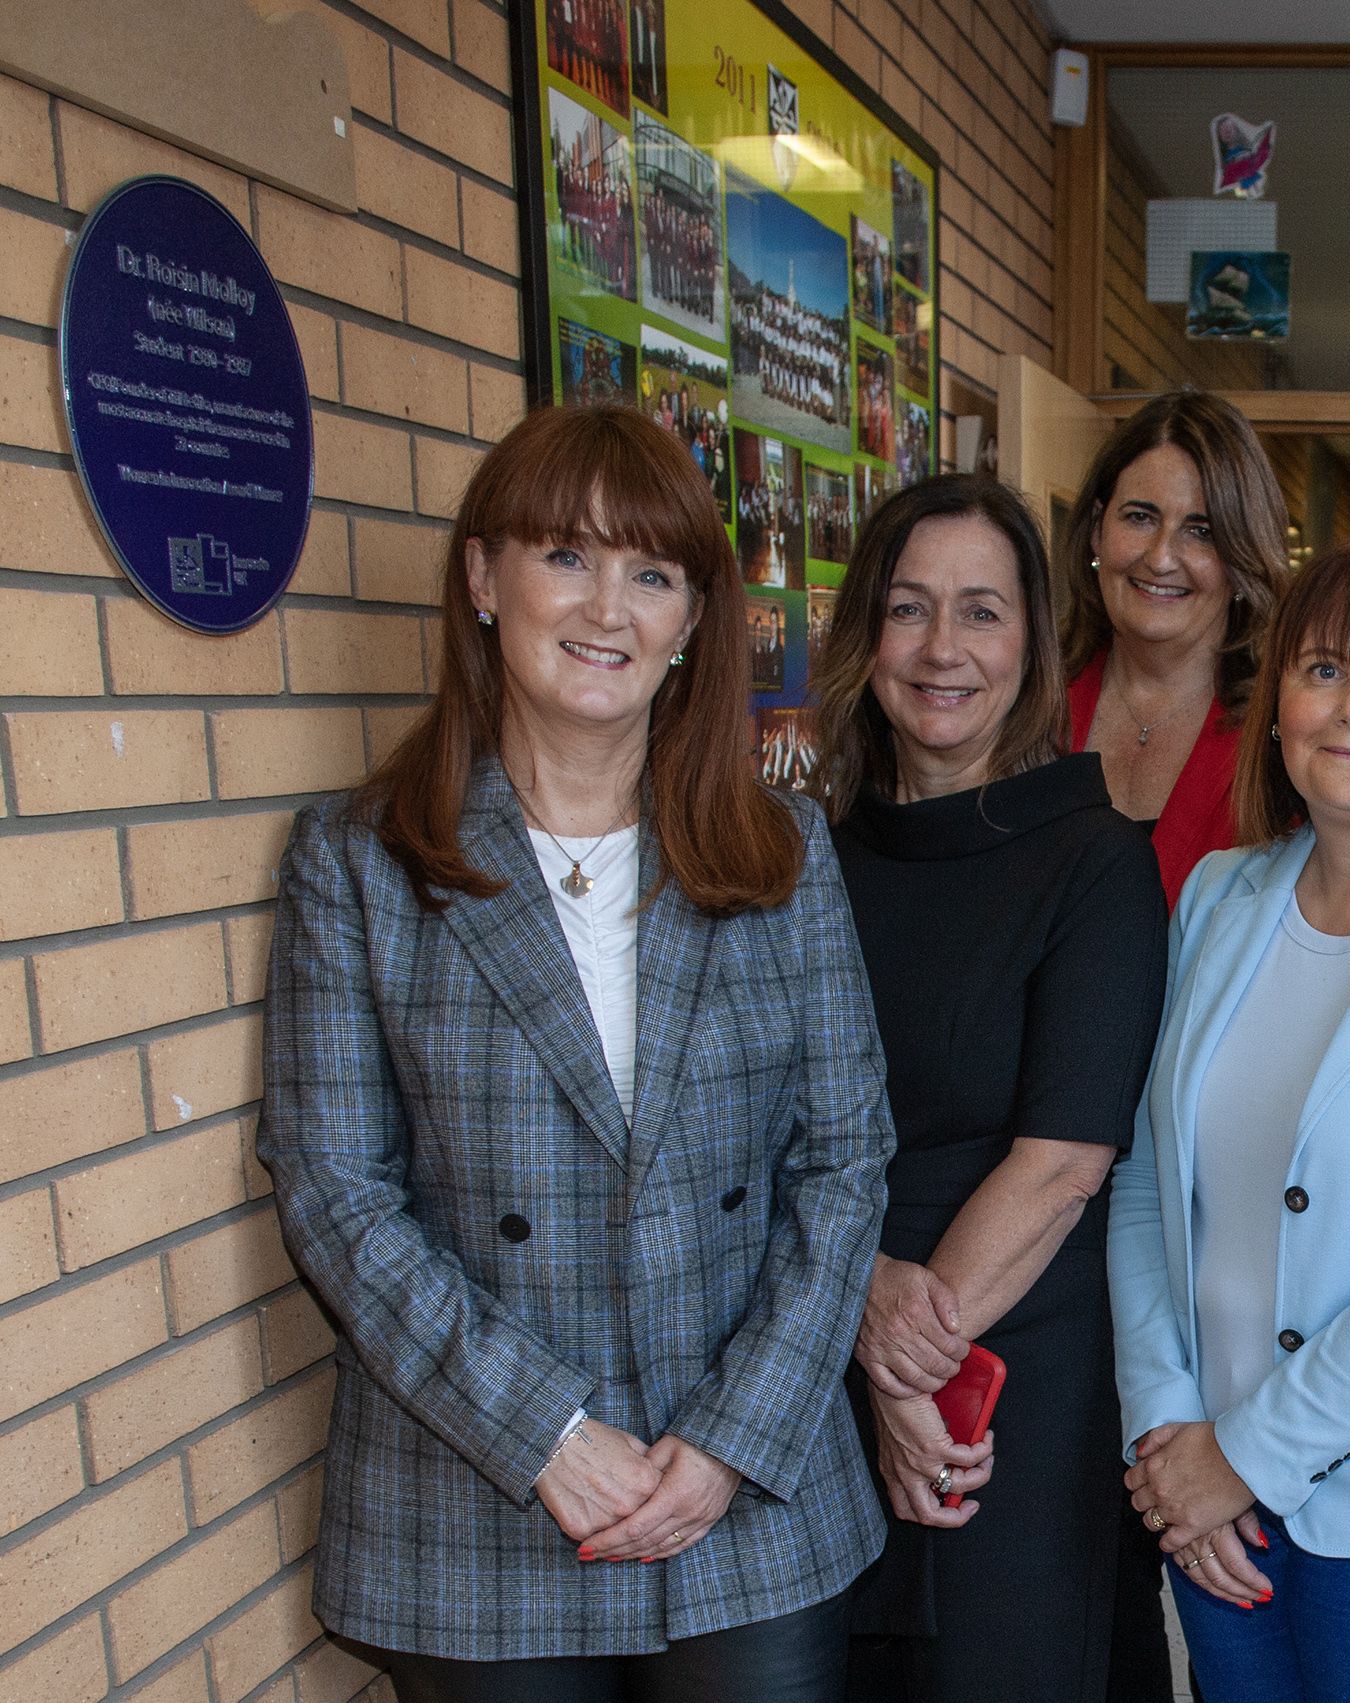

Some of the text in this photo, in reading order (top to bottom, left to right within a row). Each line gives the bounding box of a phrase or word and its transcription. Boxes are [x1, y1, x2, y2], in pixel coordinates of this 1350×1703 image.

[714, 44, 756, 114] 2011
[117, 244, 146, 279] Dr.
[201, 270, 256, 317] Molloy
[132, 329, 185, 362] Student
